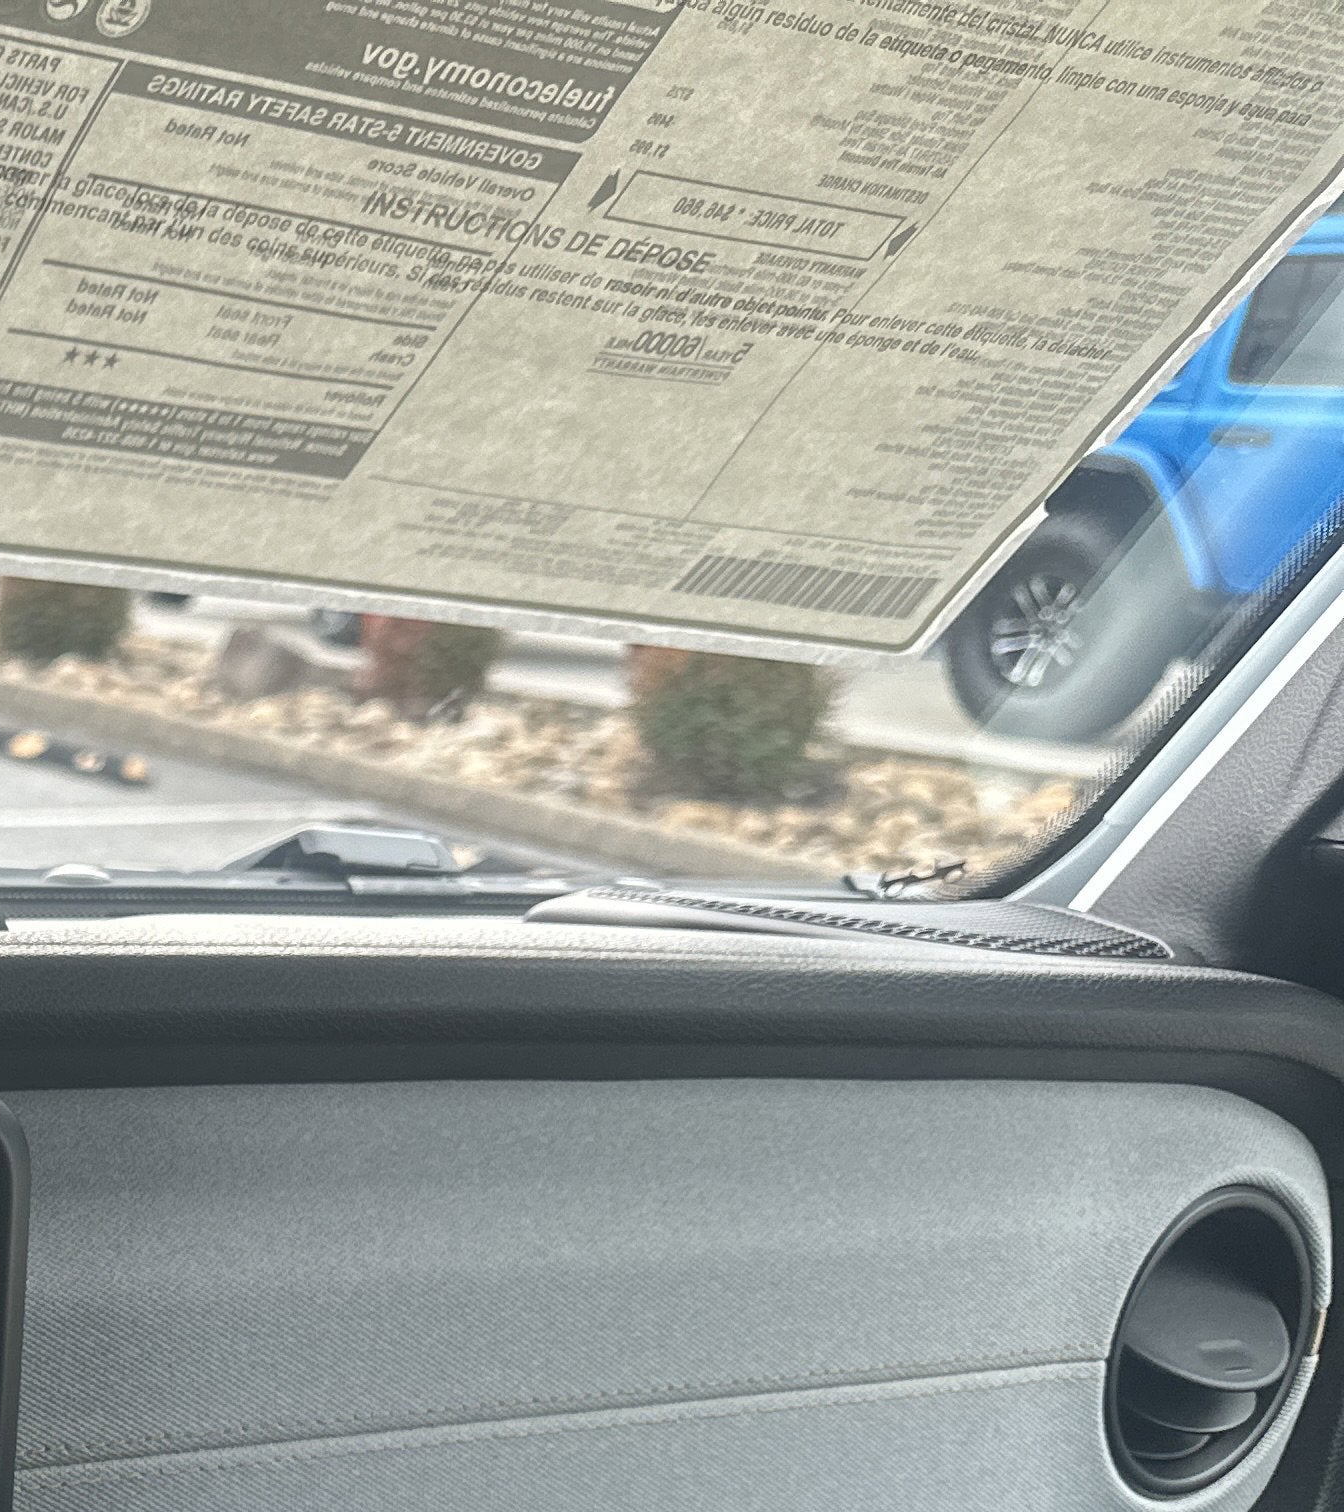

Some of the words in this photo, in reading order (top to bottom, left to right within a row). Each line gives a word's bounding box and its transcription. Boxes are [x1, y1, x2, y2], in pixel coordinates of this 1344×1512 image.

[712, 0, 767, 27] algún
[764, 10, 833, 36] residuo
[834, 22, 859, 42] de
[858, 25, 885, 46] la
[879, 28, 953, 65] etiqueta
[947, 49, 963, 63] o
[1055, 65, 1106, 90] limpie
[1104, 78, 1138, 95] con
[1135, 84, 1169, 100] una
[1166, 89, 1227, 114] esponja
[1237, 98, 1280, 120] agua
[1040, 23, 1106, 51] NUNCA
[1102, 39, 1153, 60] utilice
[1151, 46, 1256, 79] instrumentos
[363, 190, 564, 248] INSTRUCTIONS
[563, 230, 609, 256] DE
[605, 237, 715, 273] DÉPOSE
